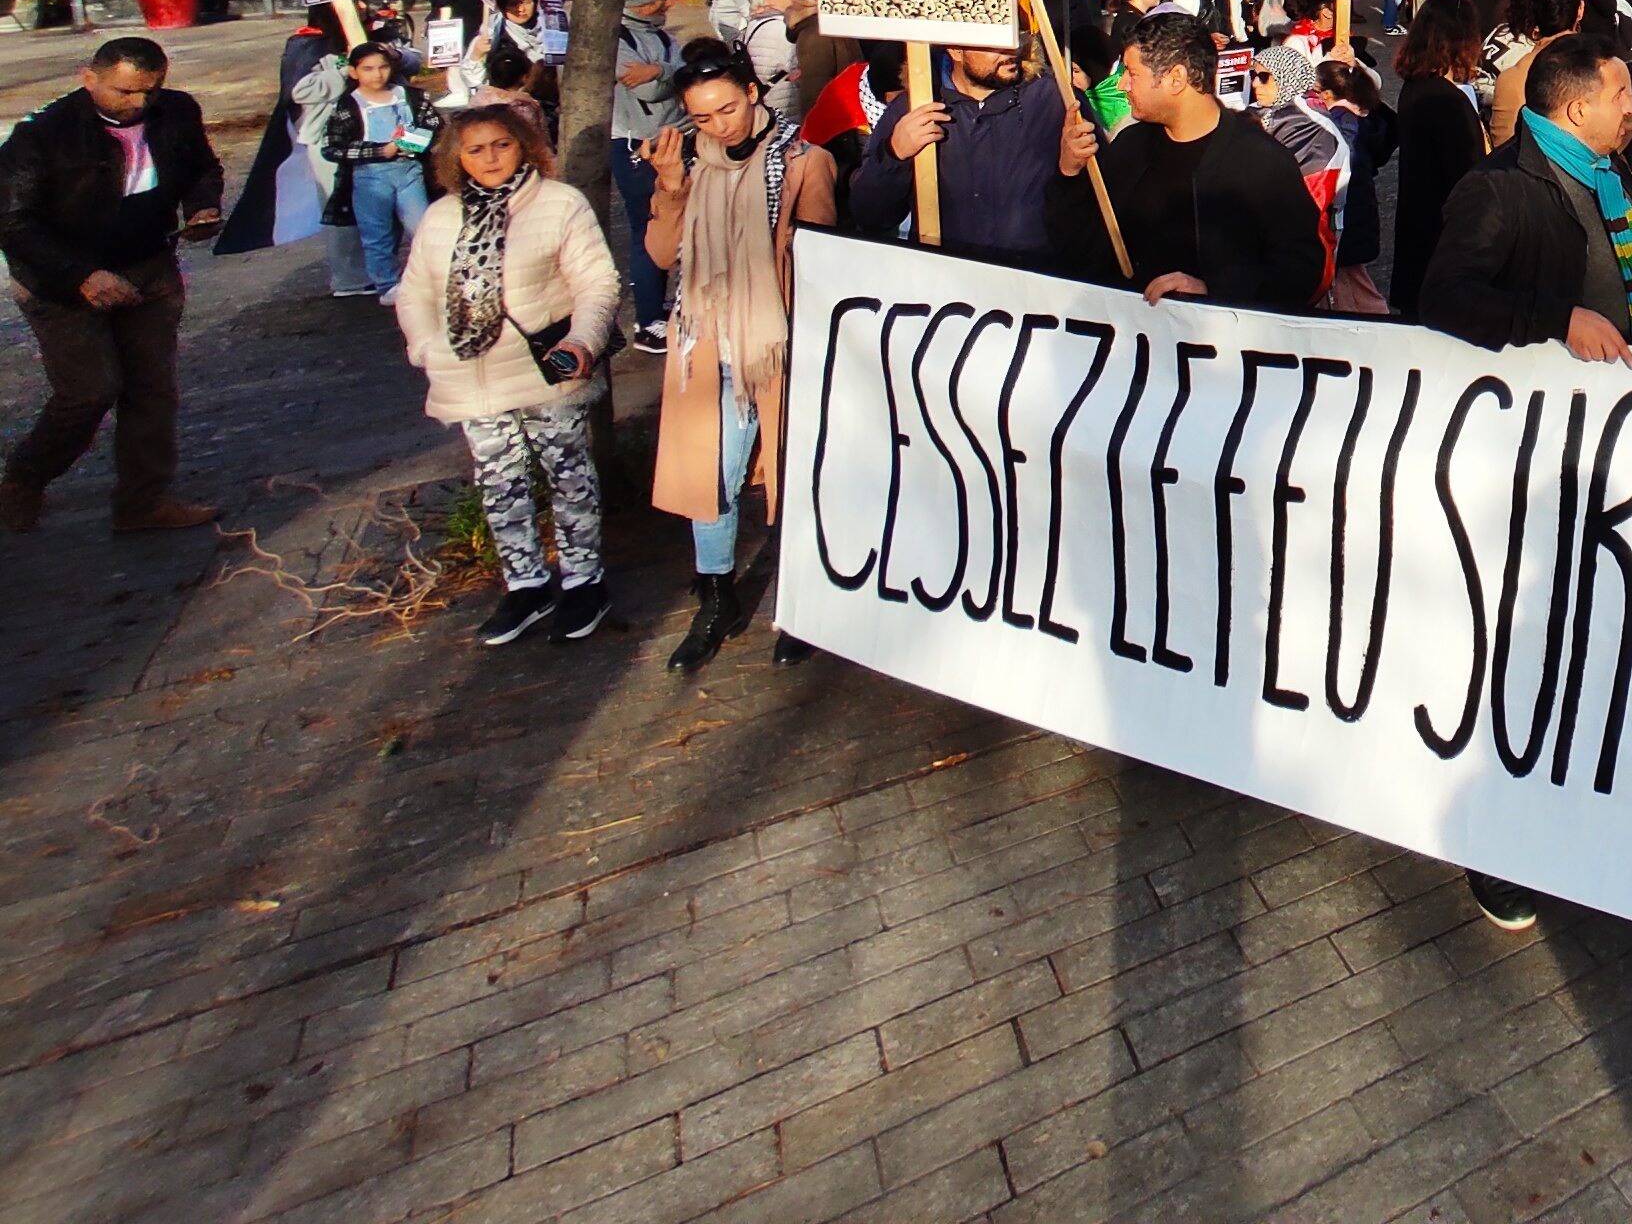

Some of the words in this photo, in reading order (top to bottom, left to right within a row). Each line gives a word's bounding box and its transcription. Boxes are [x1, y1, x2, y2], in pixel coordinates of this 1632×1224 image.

[813, 297, 1115, 644] CESSEZ
[1107, 332, 1217, 673] LE
[1214, 350, 1421, 723] FEU
